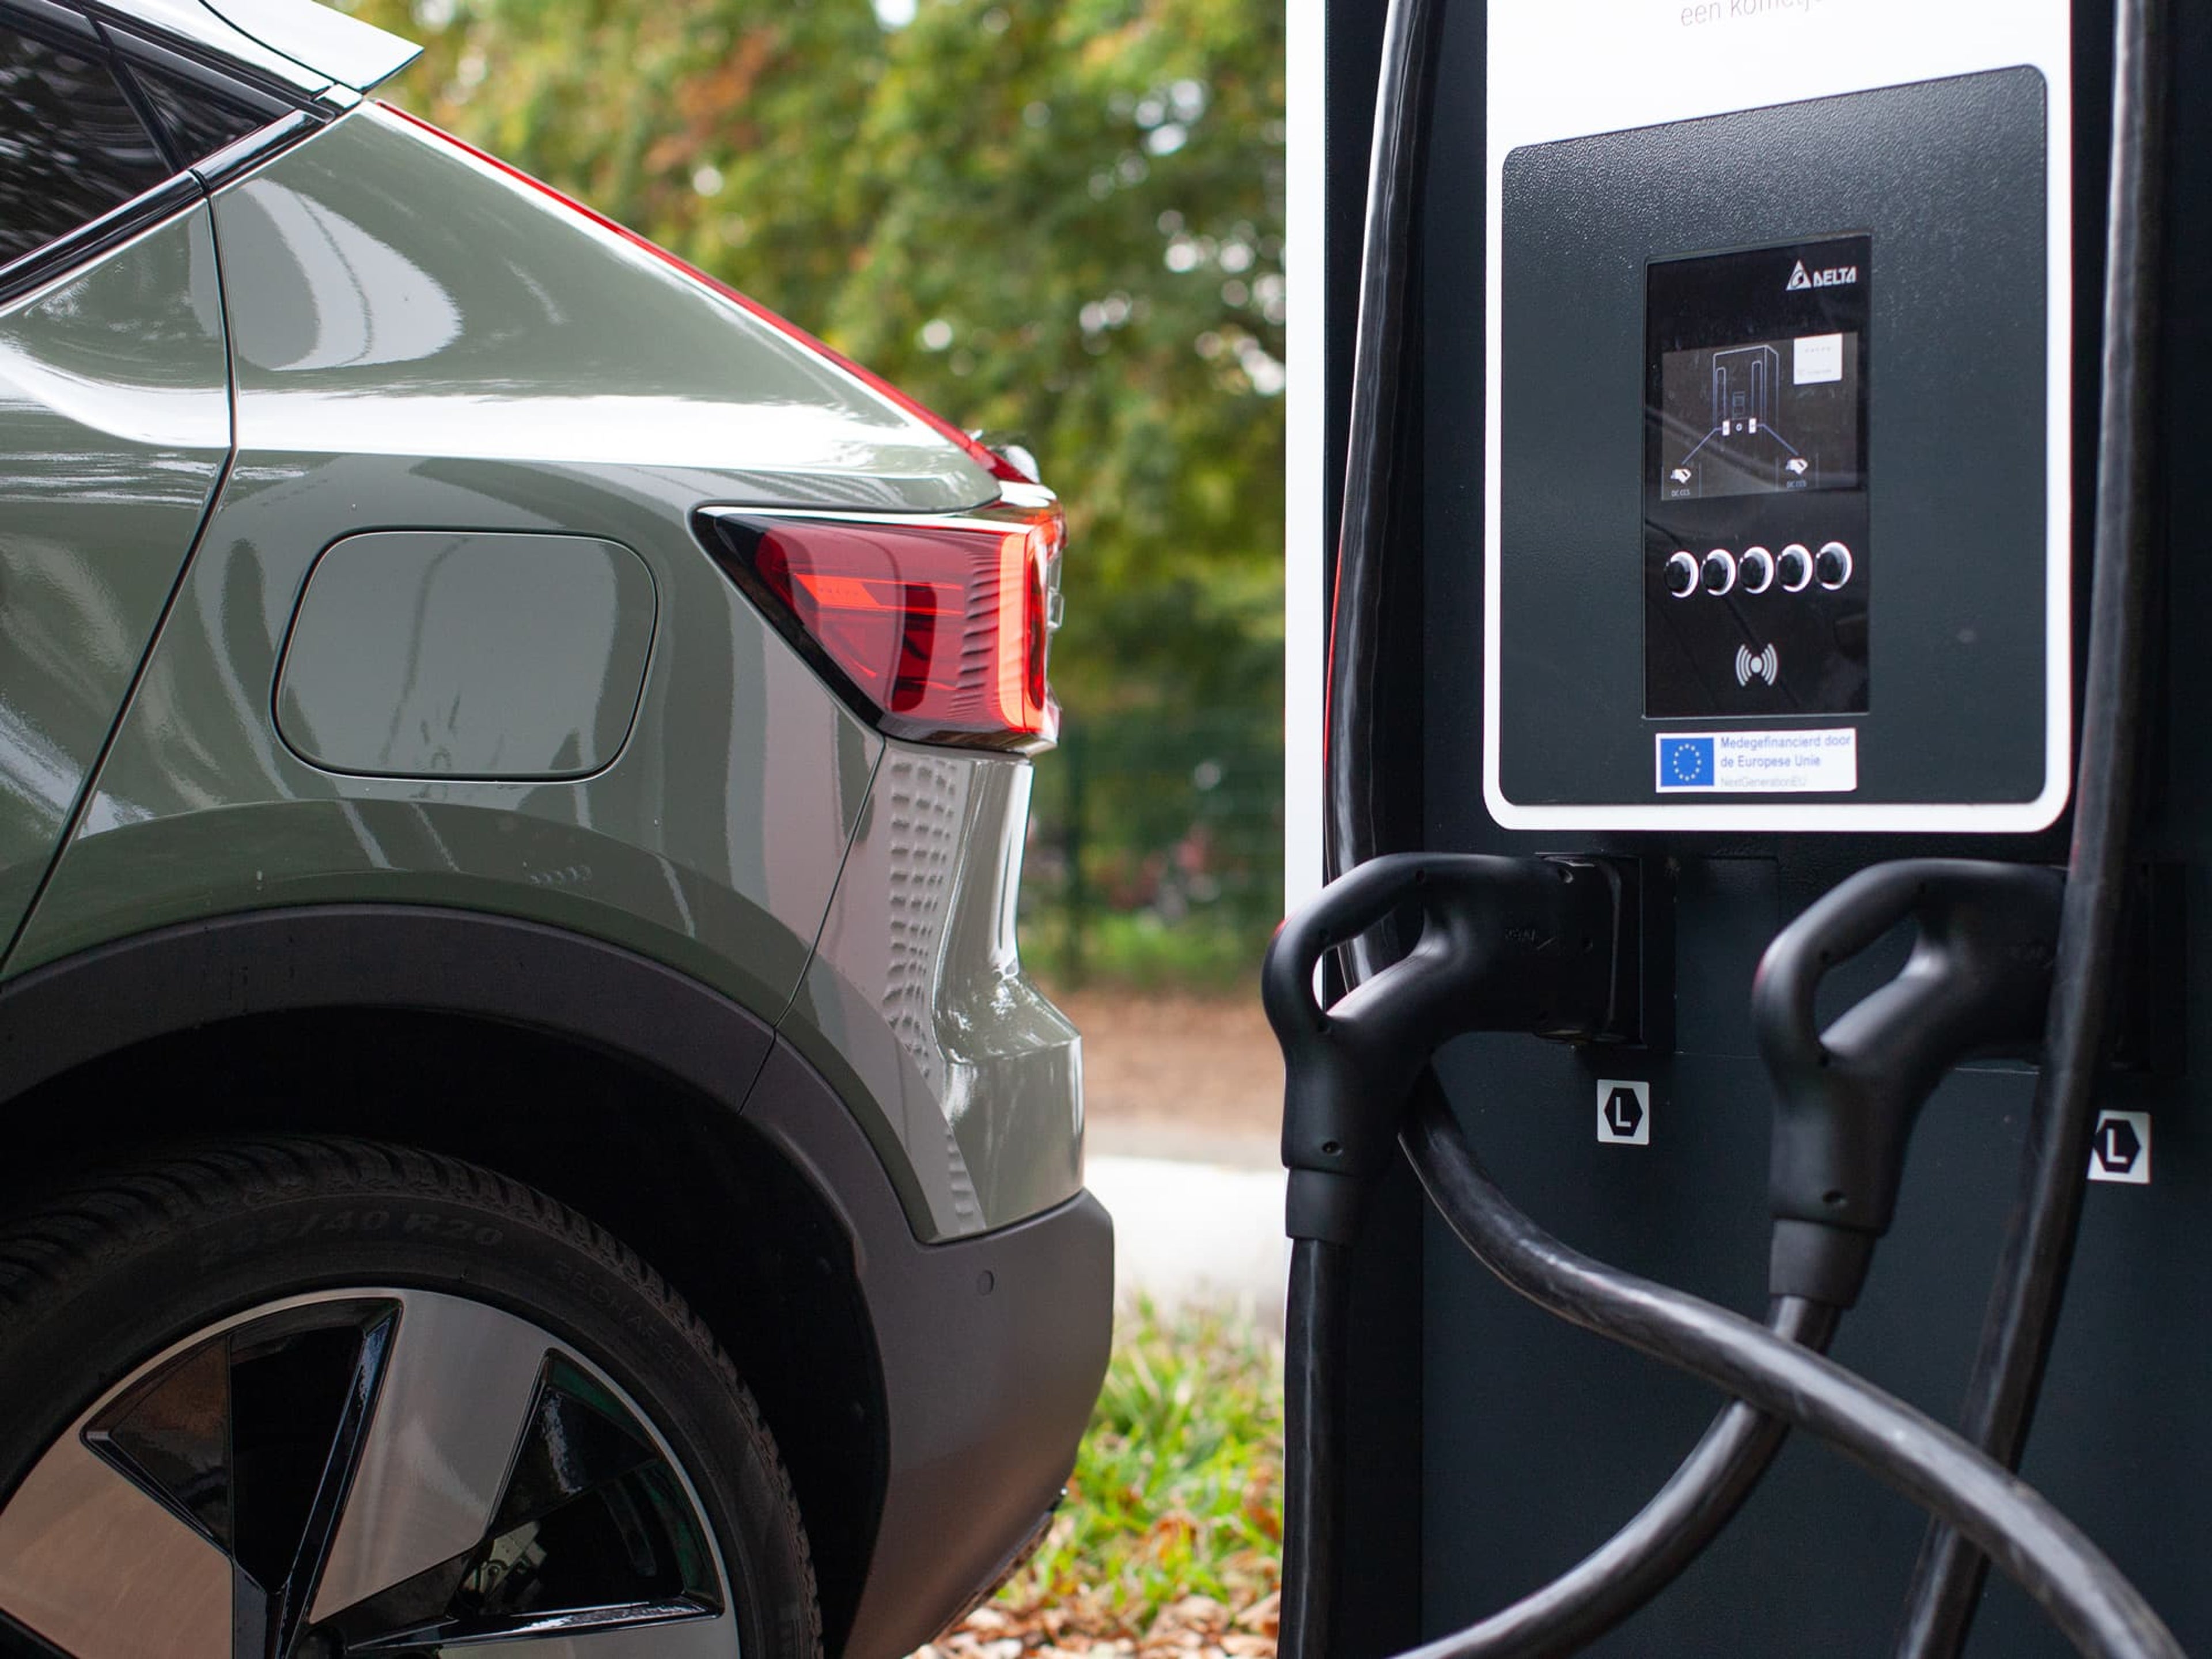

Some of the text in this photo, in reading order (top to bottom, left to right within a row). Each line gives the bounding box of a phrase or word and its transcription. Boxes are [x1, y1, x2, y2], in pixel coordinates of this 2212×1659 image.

[1680, 2, 1721, 26] een
[1813, 266, 1857, 287] DELTA
[1721, 734, 1851, 751] Medegefinancierd door
[1721, 755, 1820, 768] de Europese Unie
[1616, 1096, 1631, 1127] L
[2107, 1128, 2127, 1164] L
